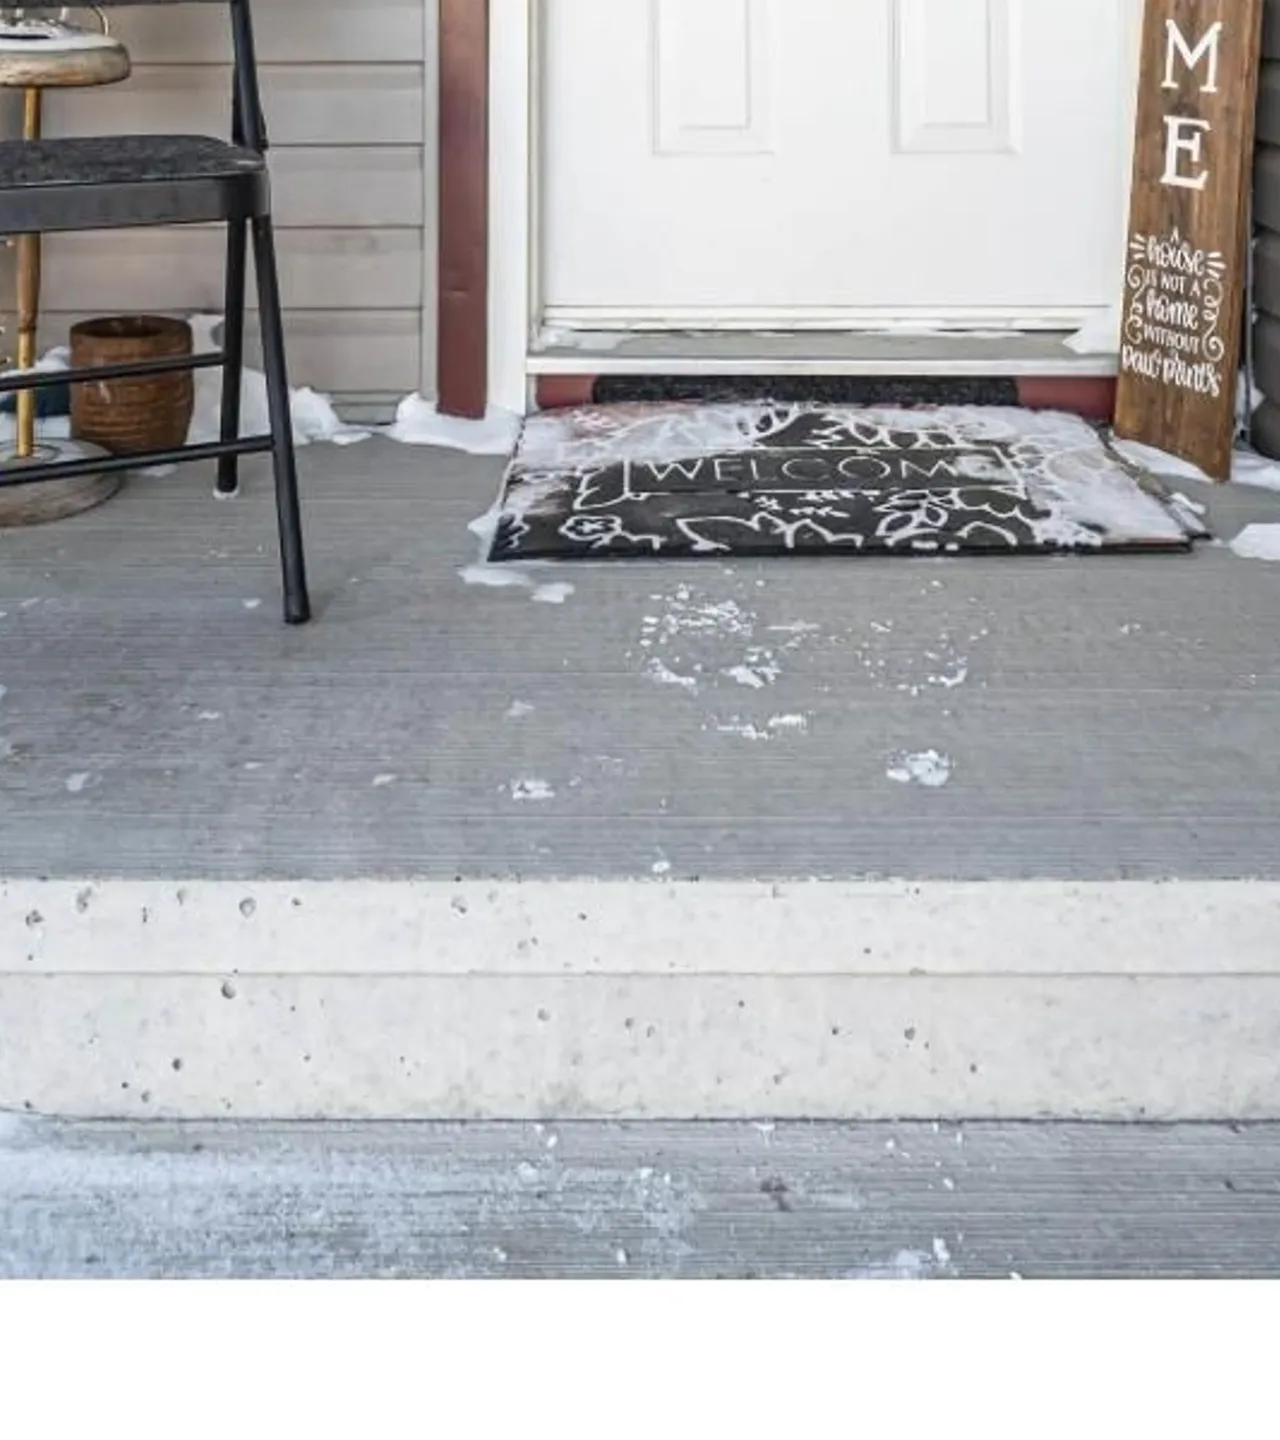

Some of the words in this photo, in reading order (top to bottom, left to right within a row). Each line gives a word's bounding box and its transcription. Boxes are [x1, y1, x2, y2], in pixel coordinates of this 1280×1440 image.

[1161, 271, 1187, 295] NOT
[1190, 279, 1201, 298] A
[1143, 323, 1201, 355] WITHOUT
[645, 456, 996, 483] WELCOM
